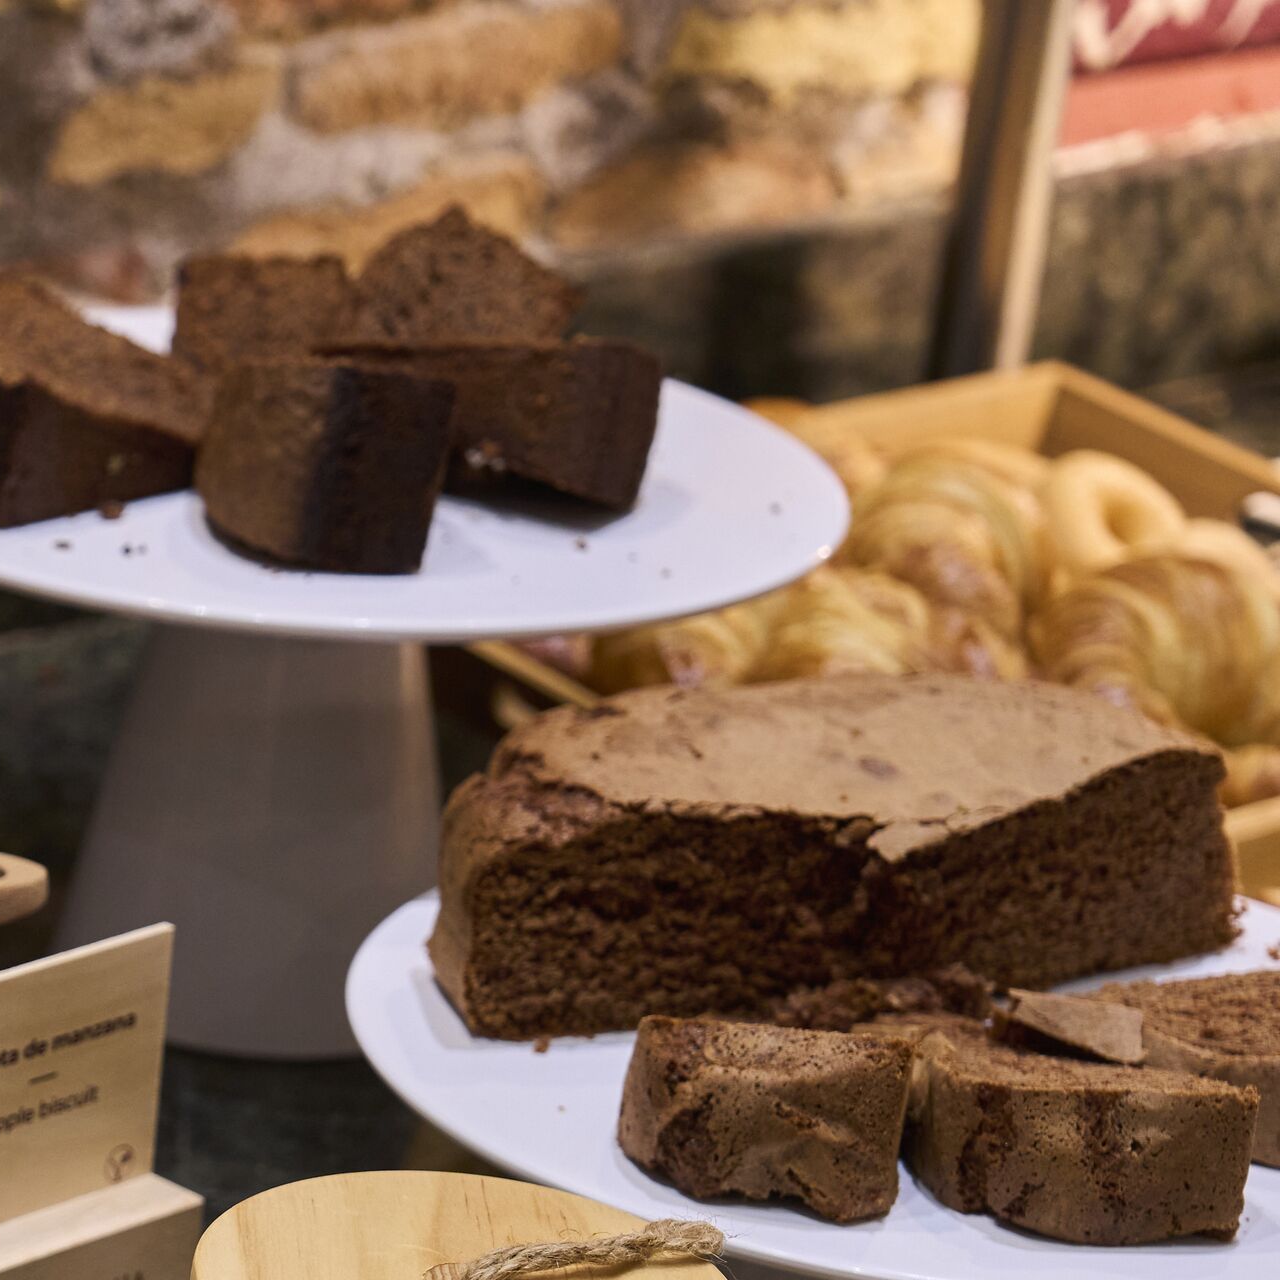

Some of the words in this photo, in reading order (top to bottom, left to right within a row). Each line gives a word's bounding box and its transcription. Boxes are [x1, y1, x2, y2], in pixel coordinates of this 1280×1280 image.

[23, 1038, 48, 1059] de
[51, 1012, 137, 1050] manzana
[38, 1084, 99, 1119] biscuit
